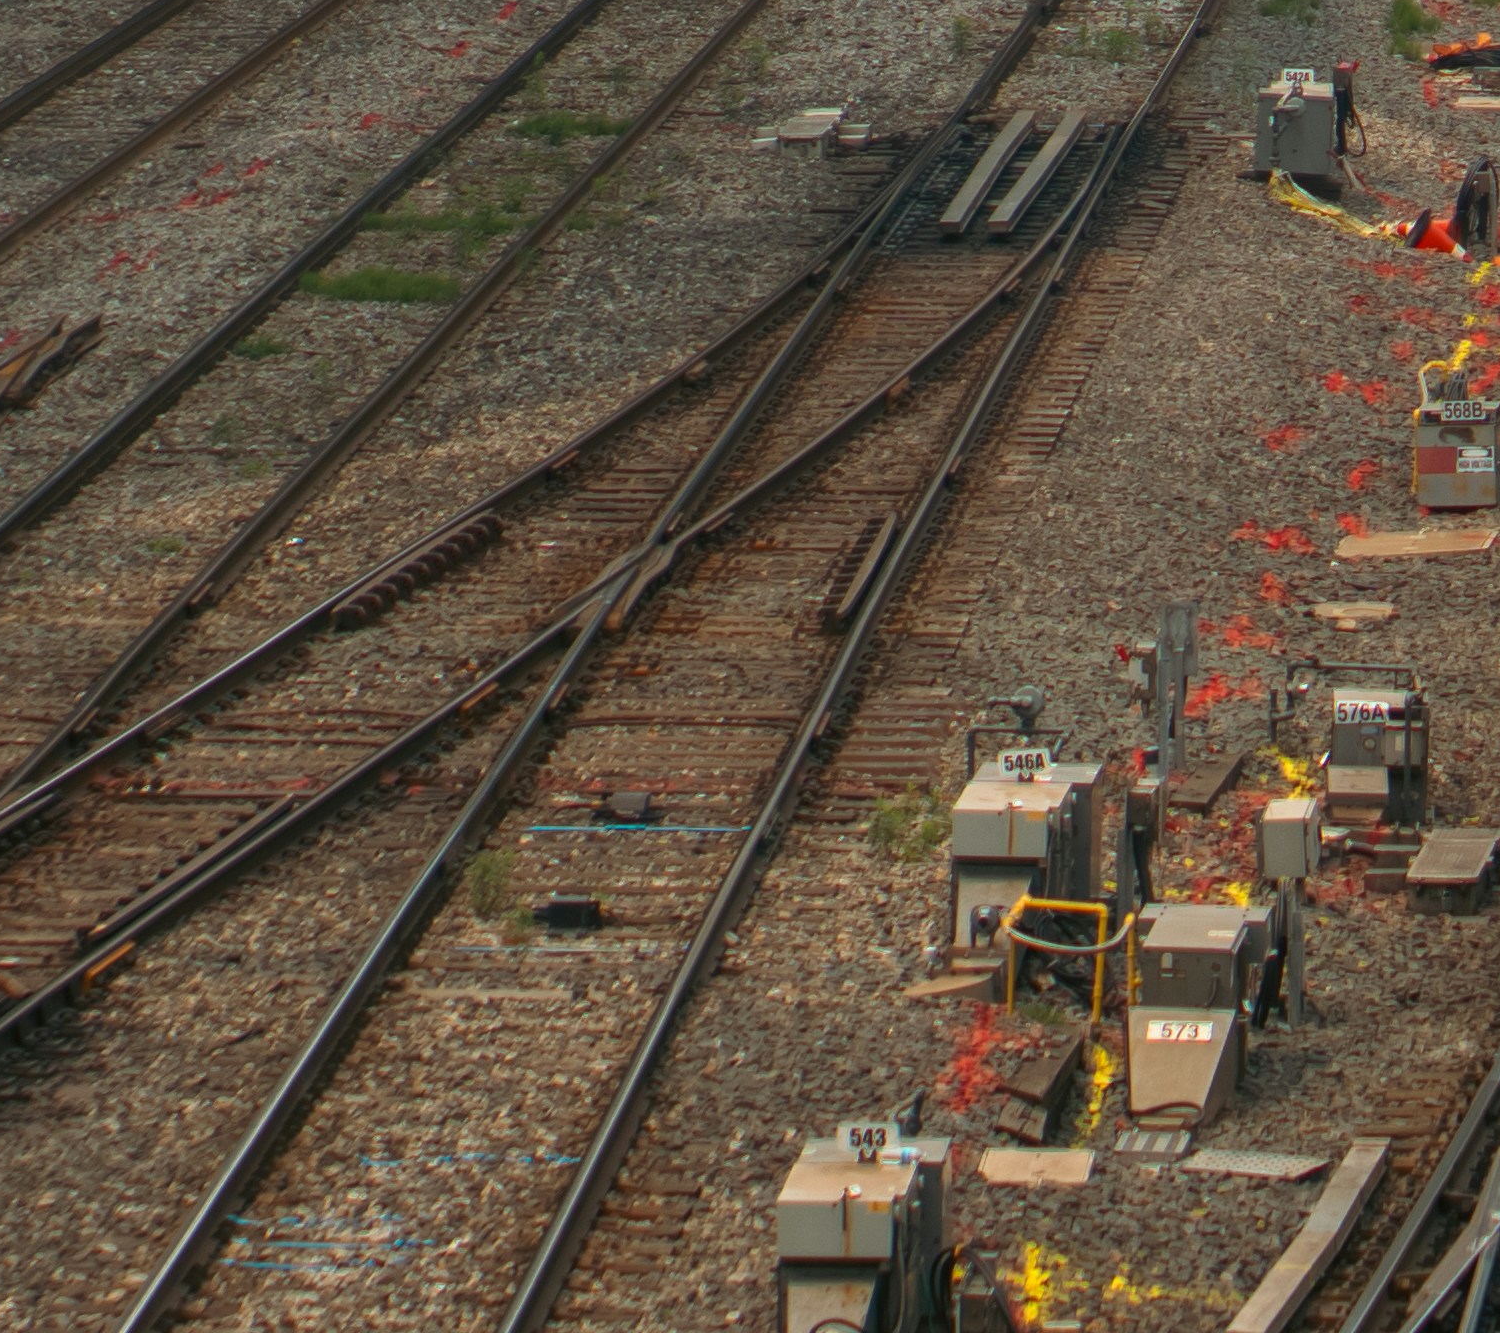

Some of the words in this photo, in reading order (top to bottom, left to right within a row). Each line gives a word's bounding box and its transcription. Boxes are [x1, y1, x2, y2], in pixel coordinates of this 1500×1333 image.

[1285, 71, 1311, 82] 542A
[1444, 402, 1483, 419] 568B
[1337, 703, 1385, 721] 576A
[1003, 752, 1045, 771] 546A
[1161, 1022, 1200, 1040] 573
[849, 1127, 887, 1146] 543
